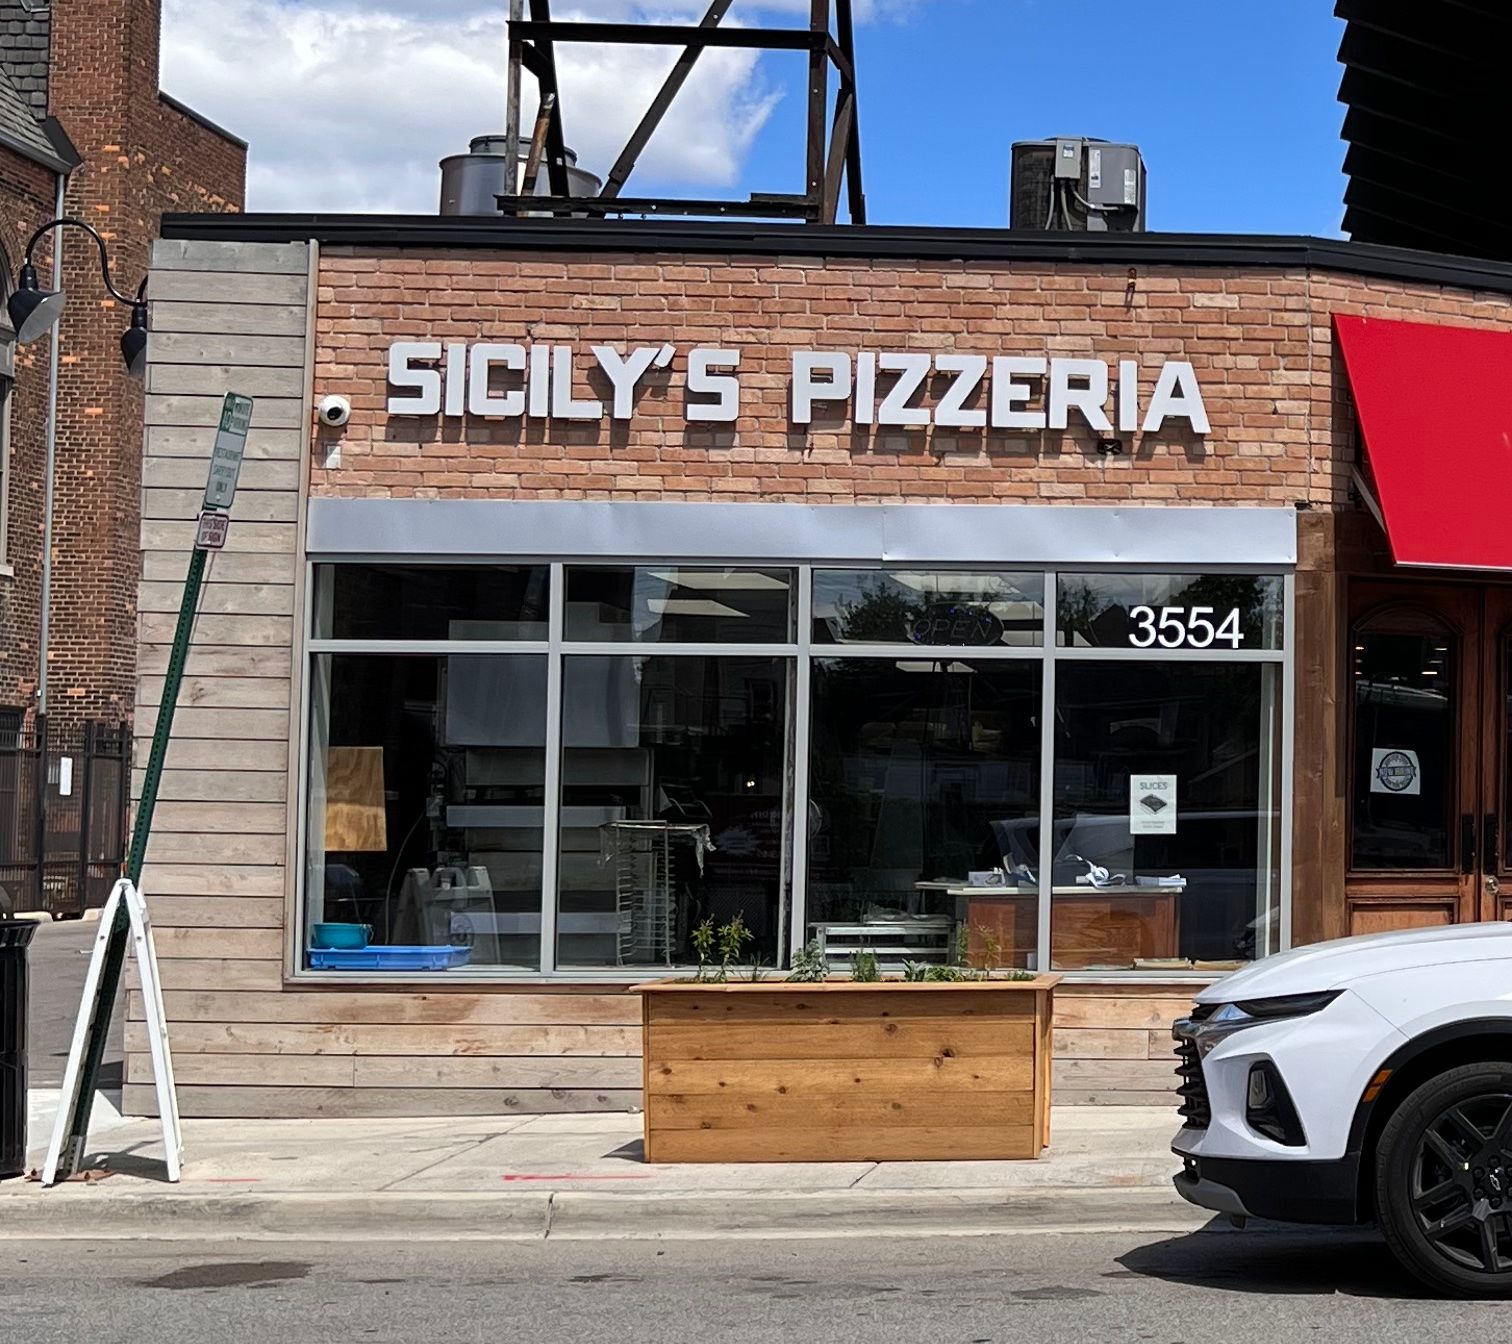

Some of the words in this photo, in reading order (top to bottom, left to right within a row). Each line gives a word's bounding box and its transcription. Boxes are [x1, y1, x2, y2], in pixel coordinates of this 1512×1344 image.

[387, 341, 741, 423] SICILY'S
[792, 351, 1212, 435] PIZZERIA
[914, 618, 993, 639] OPEN
[1128, 606, 1244, 649] 3554
[1140, 781, 1168, 791] SLICES
